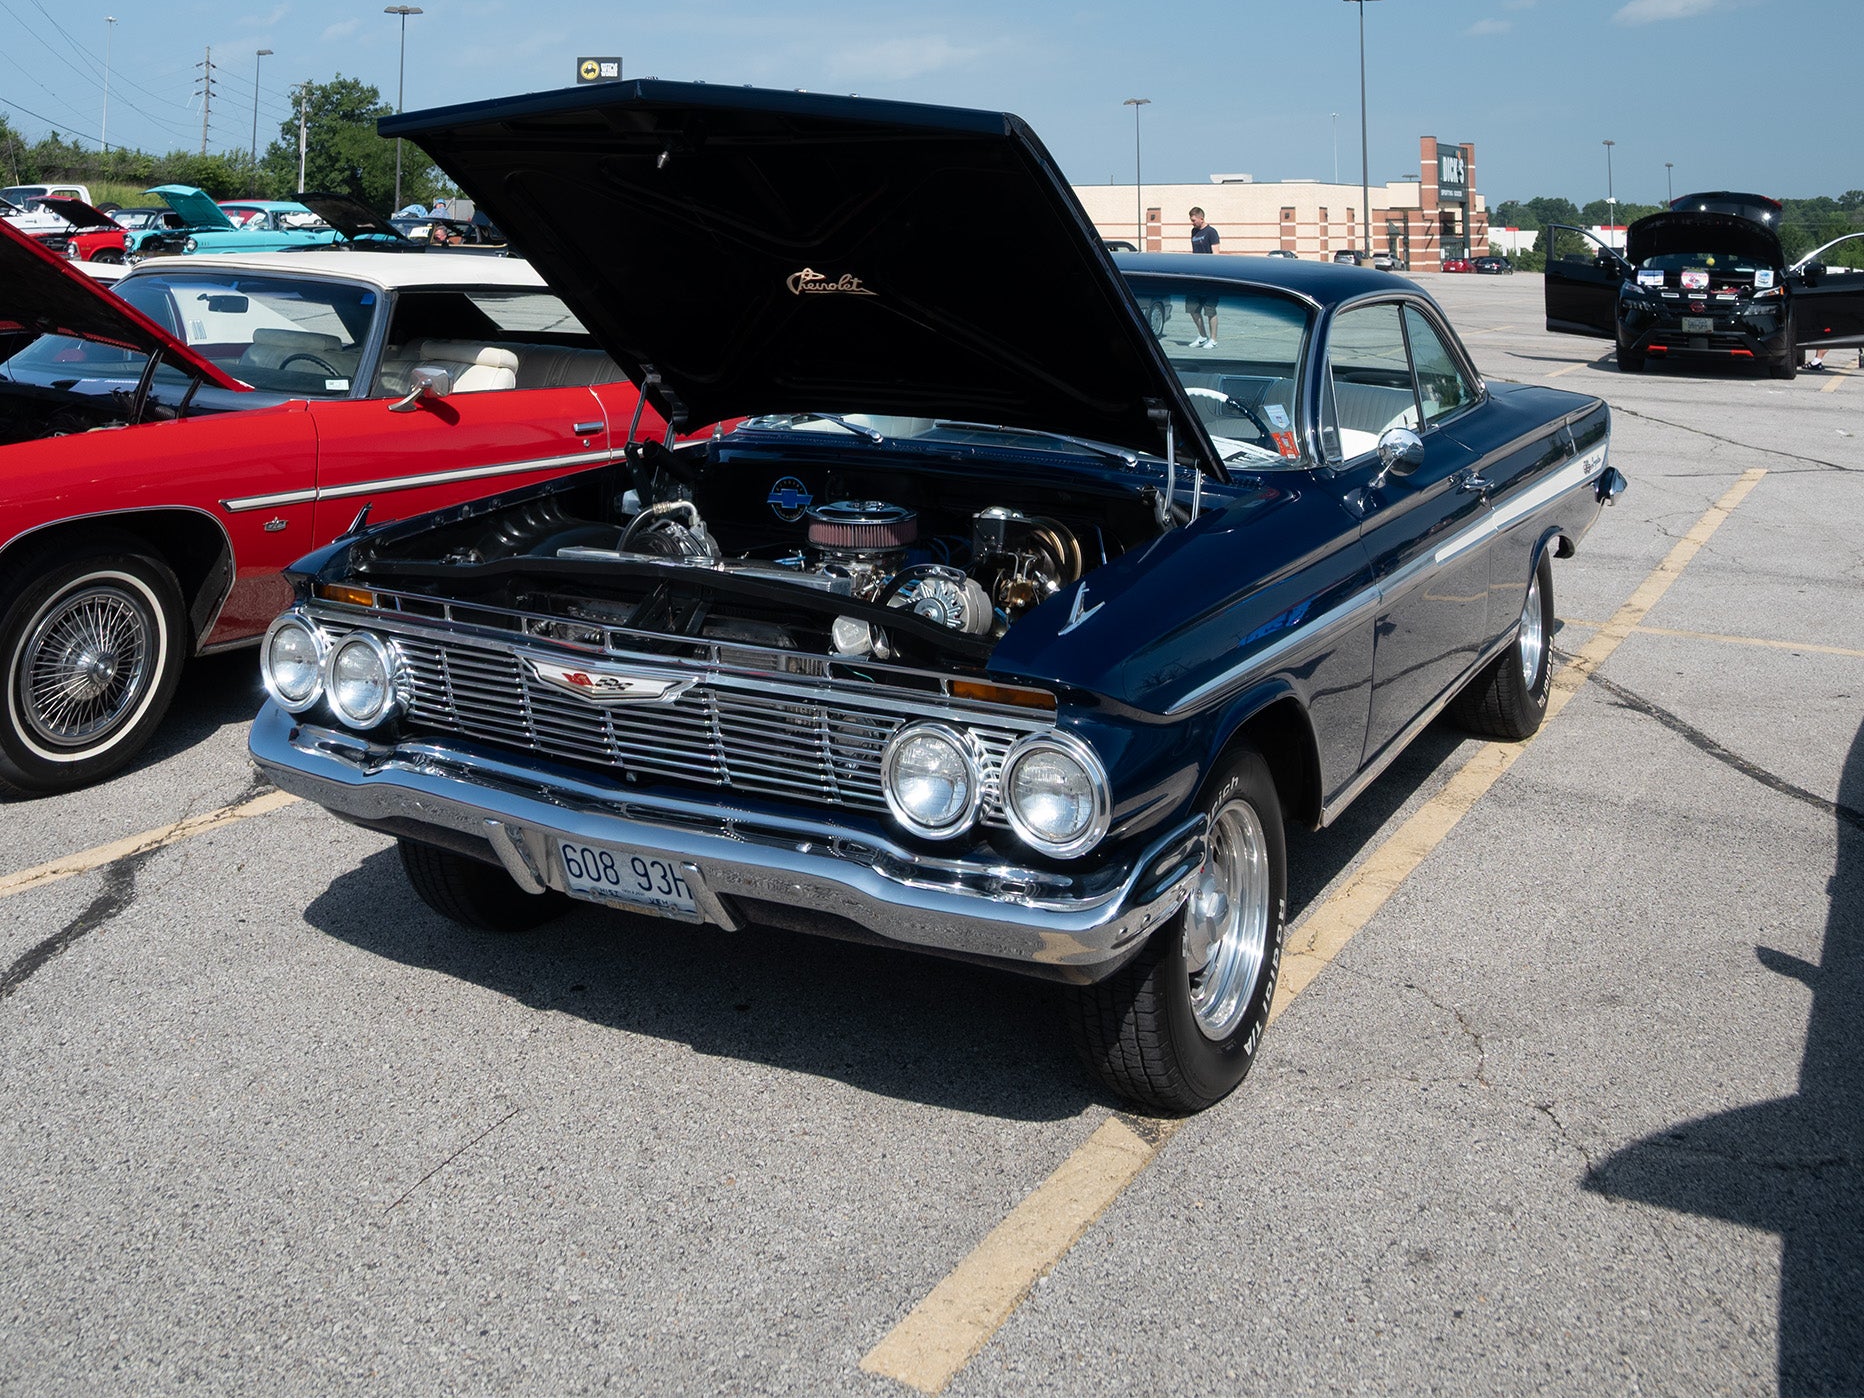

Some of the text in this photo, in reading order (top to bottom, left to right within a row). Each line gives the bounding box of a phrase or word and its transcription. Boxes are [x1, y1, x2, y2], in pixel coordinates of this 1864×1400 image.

[1443, 151, 1465, 184] DICK'S
[786, 267, 880, 296] Chevrolet
[561, 843, 694, 900] 608 93H
